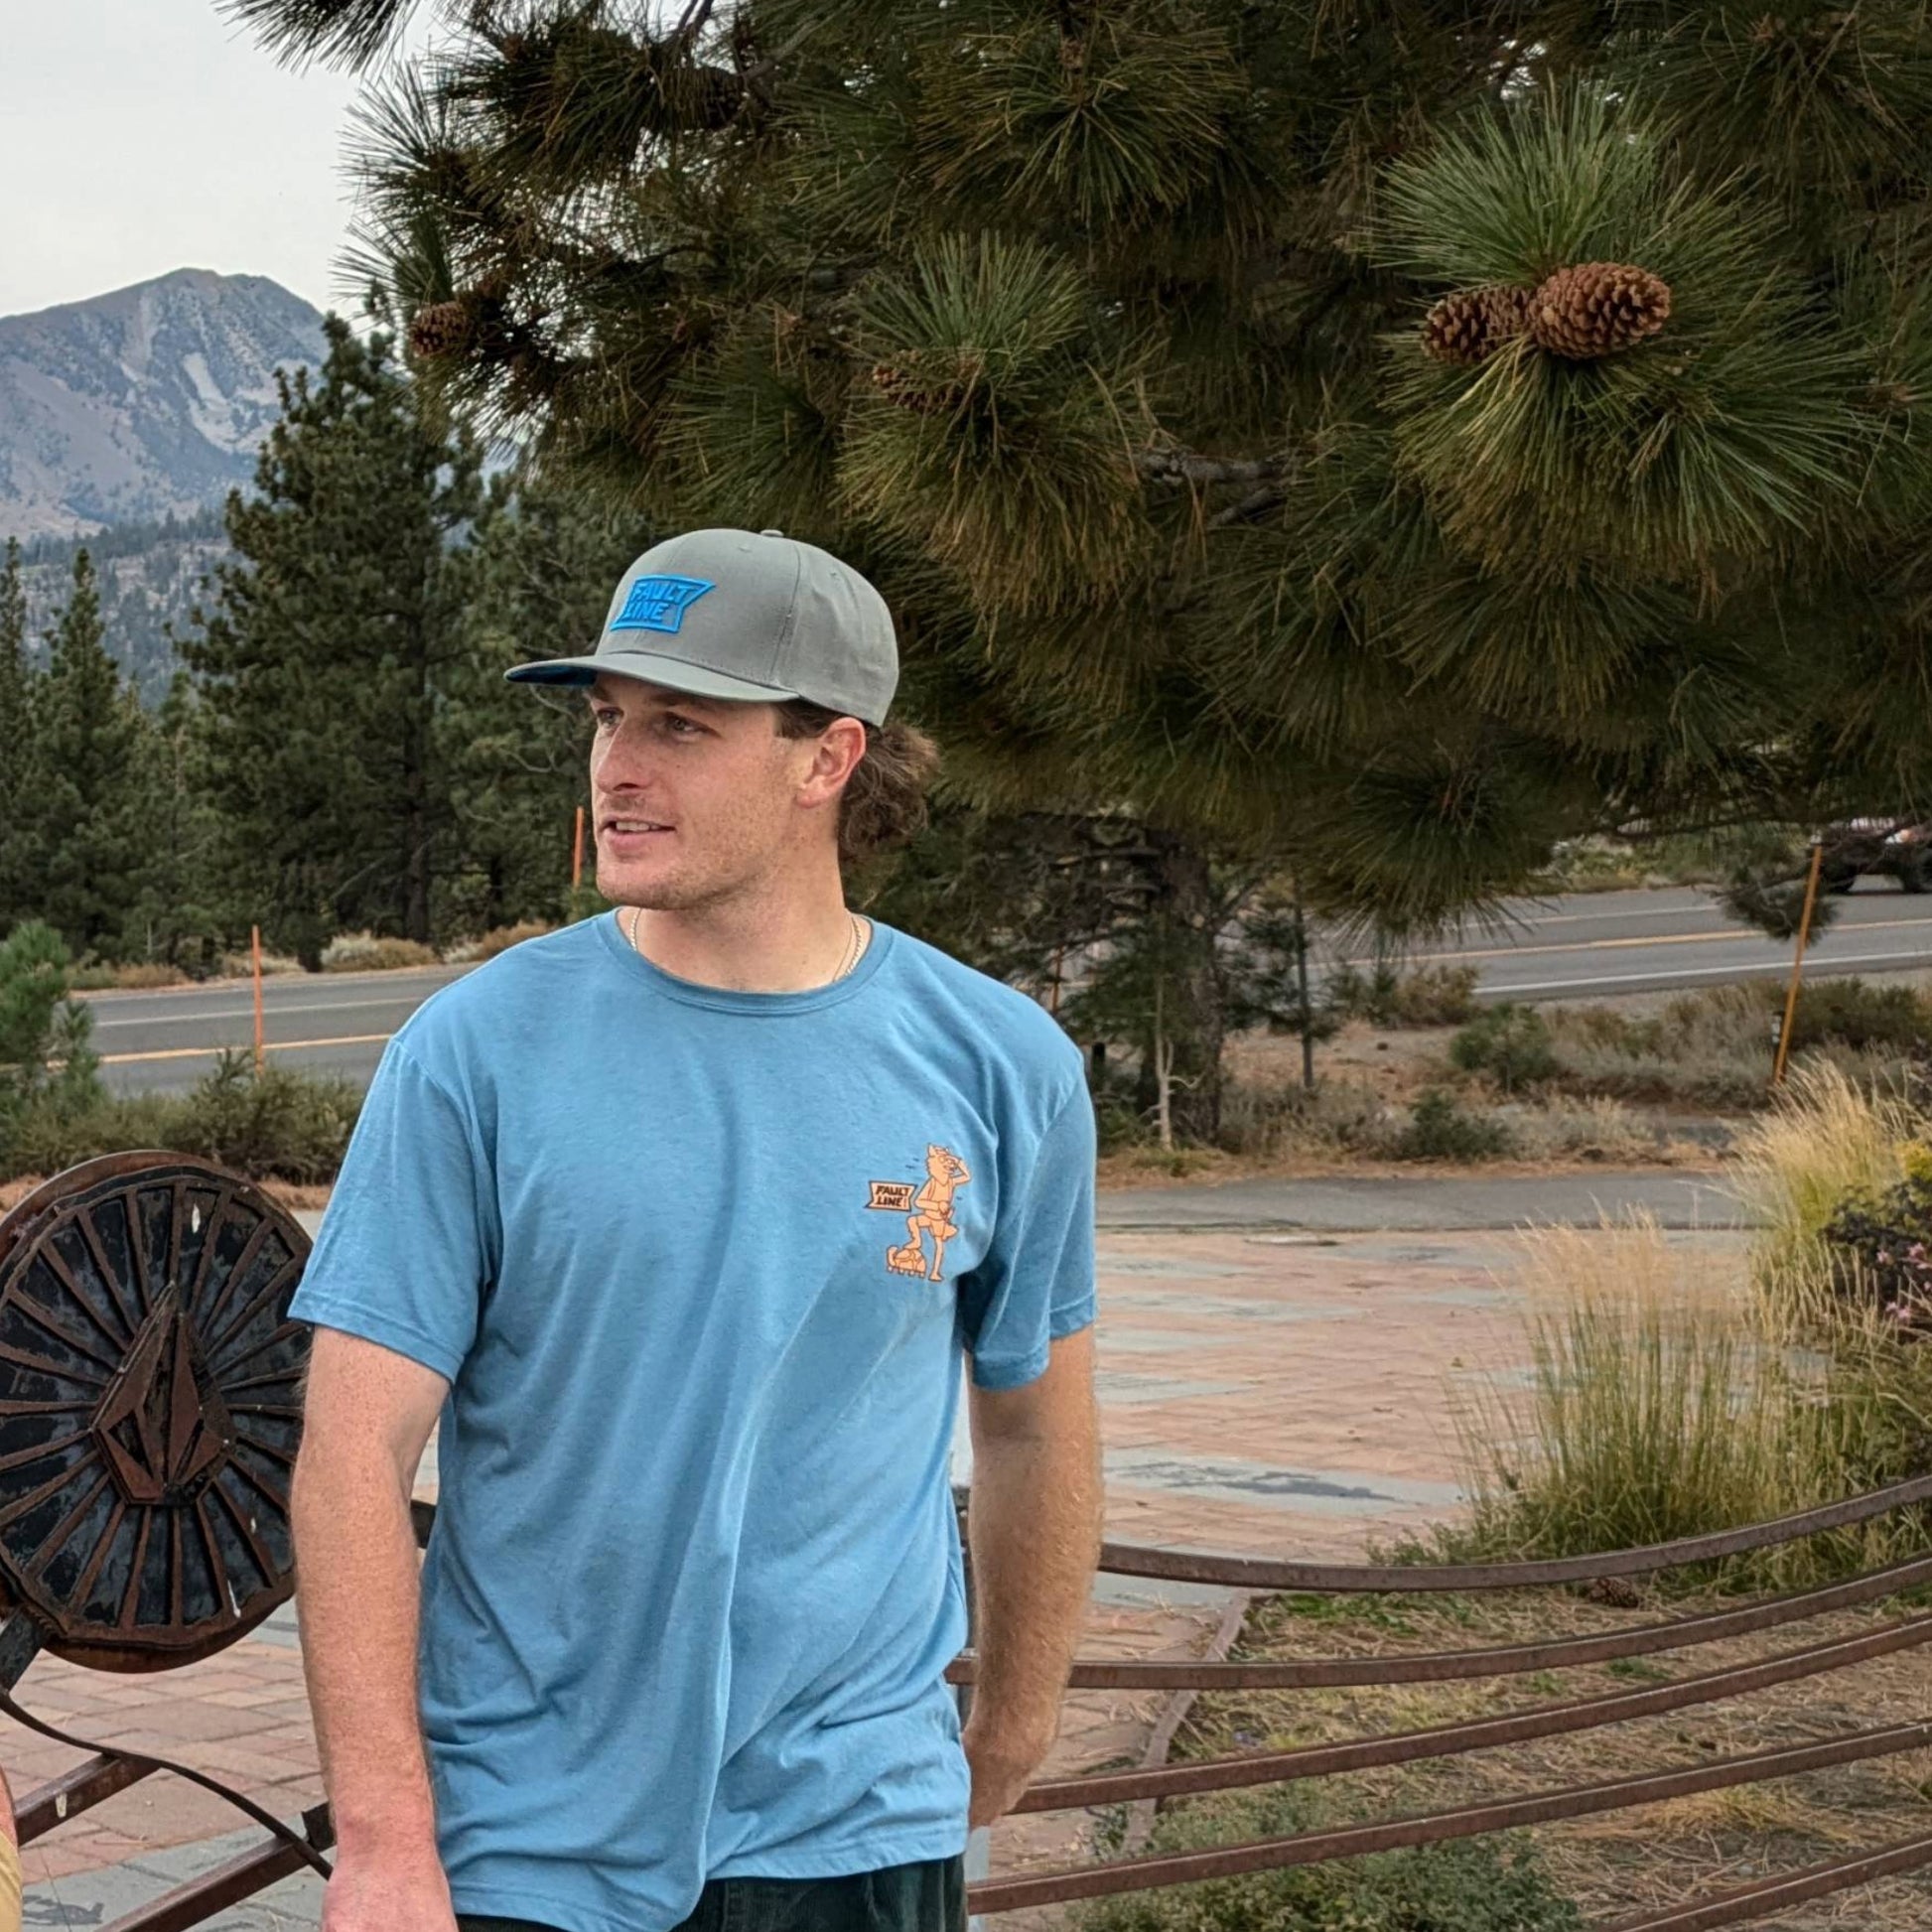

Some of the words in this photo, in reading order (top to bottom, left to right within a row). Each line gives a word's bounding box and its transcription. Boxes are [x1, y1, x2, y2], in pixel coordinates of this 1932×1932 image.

[630, 583, 694, 604] FAULT
[622, 602, 669, 621] LINE
[875, 1185, 910, 1196] FAULT
[875, 1195, 902, 1207] LINE
